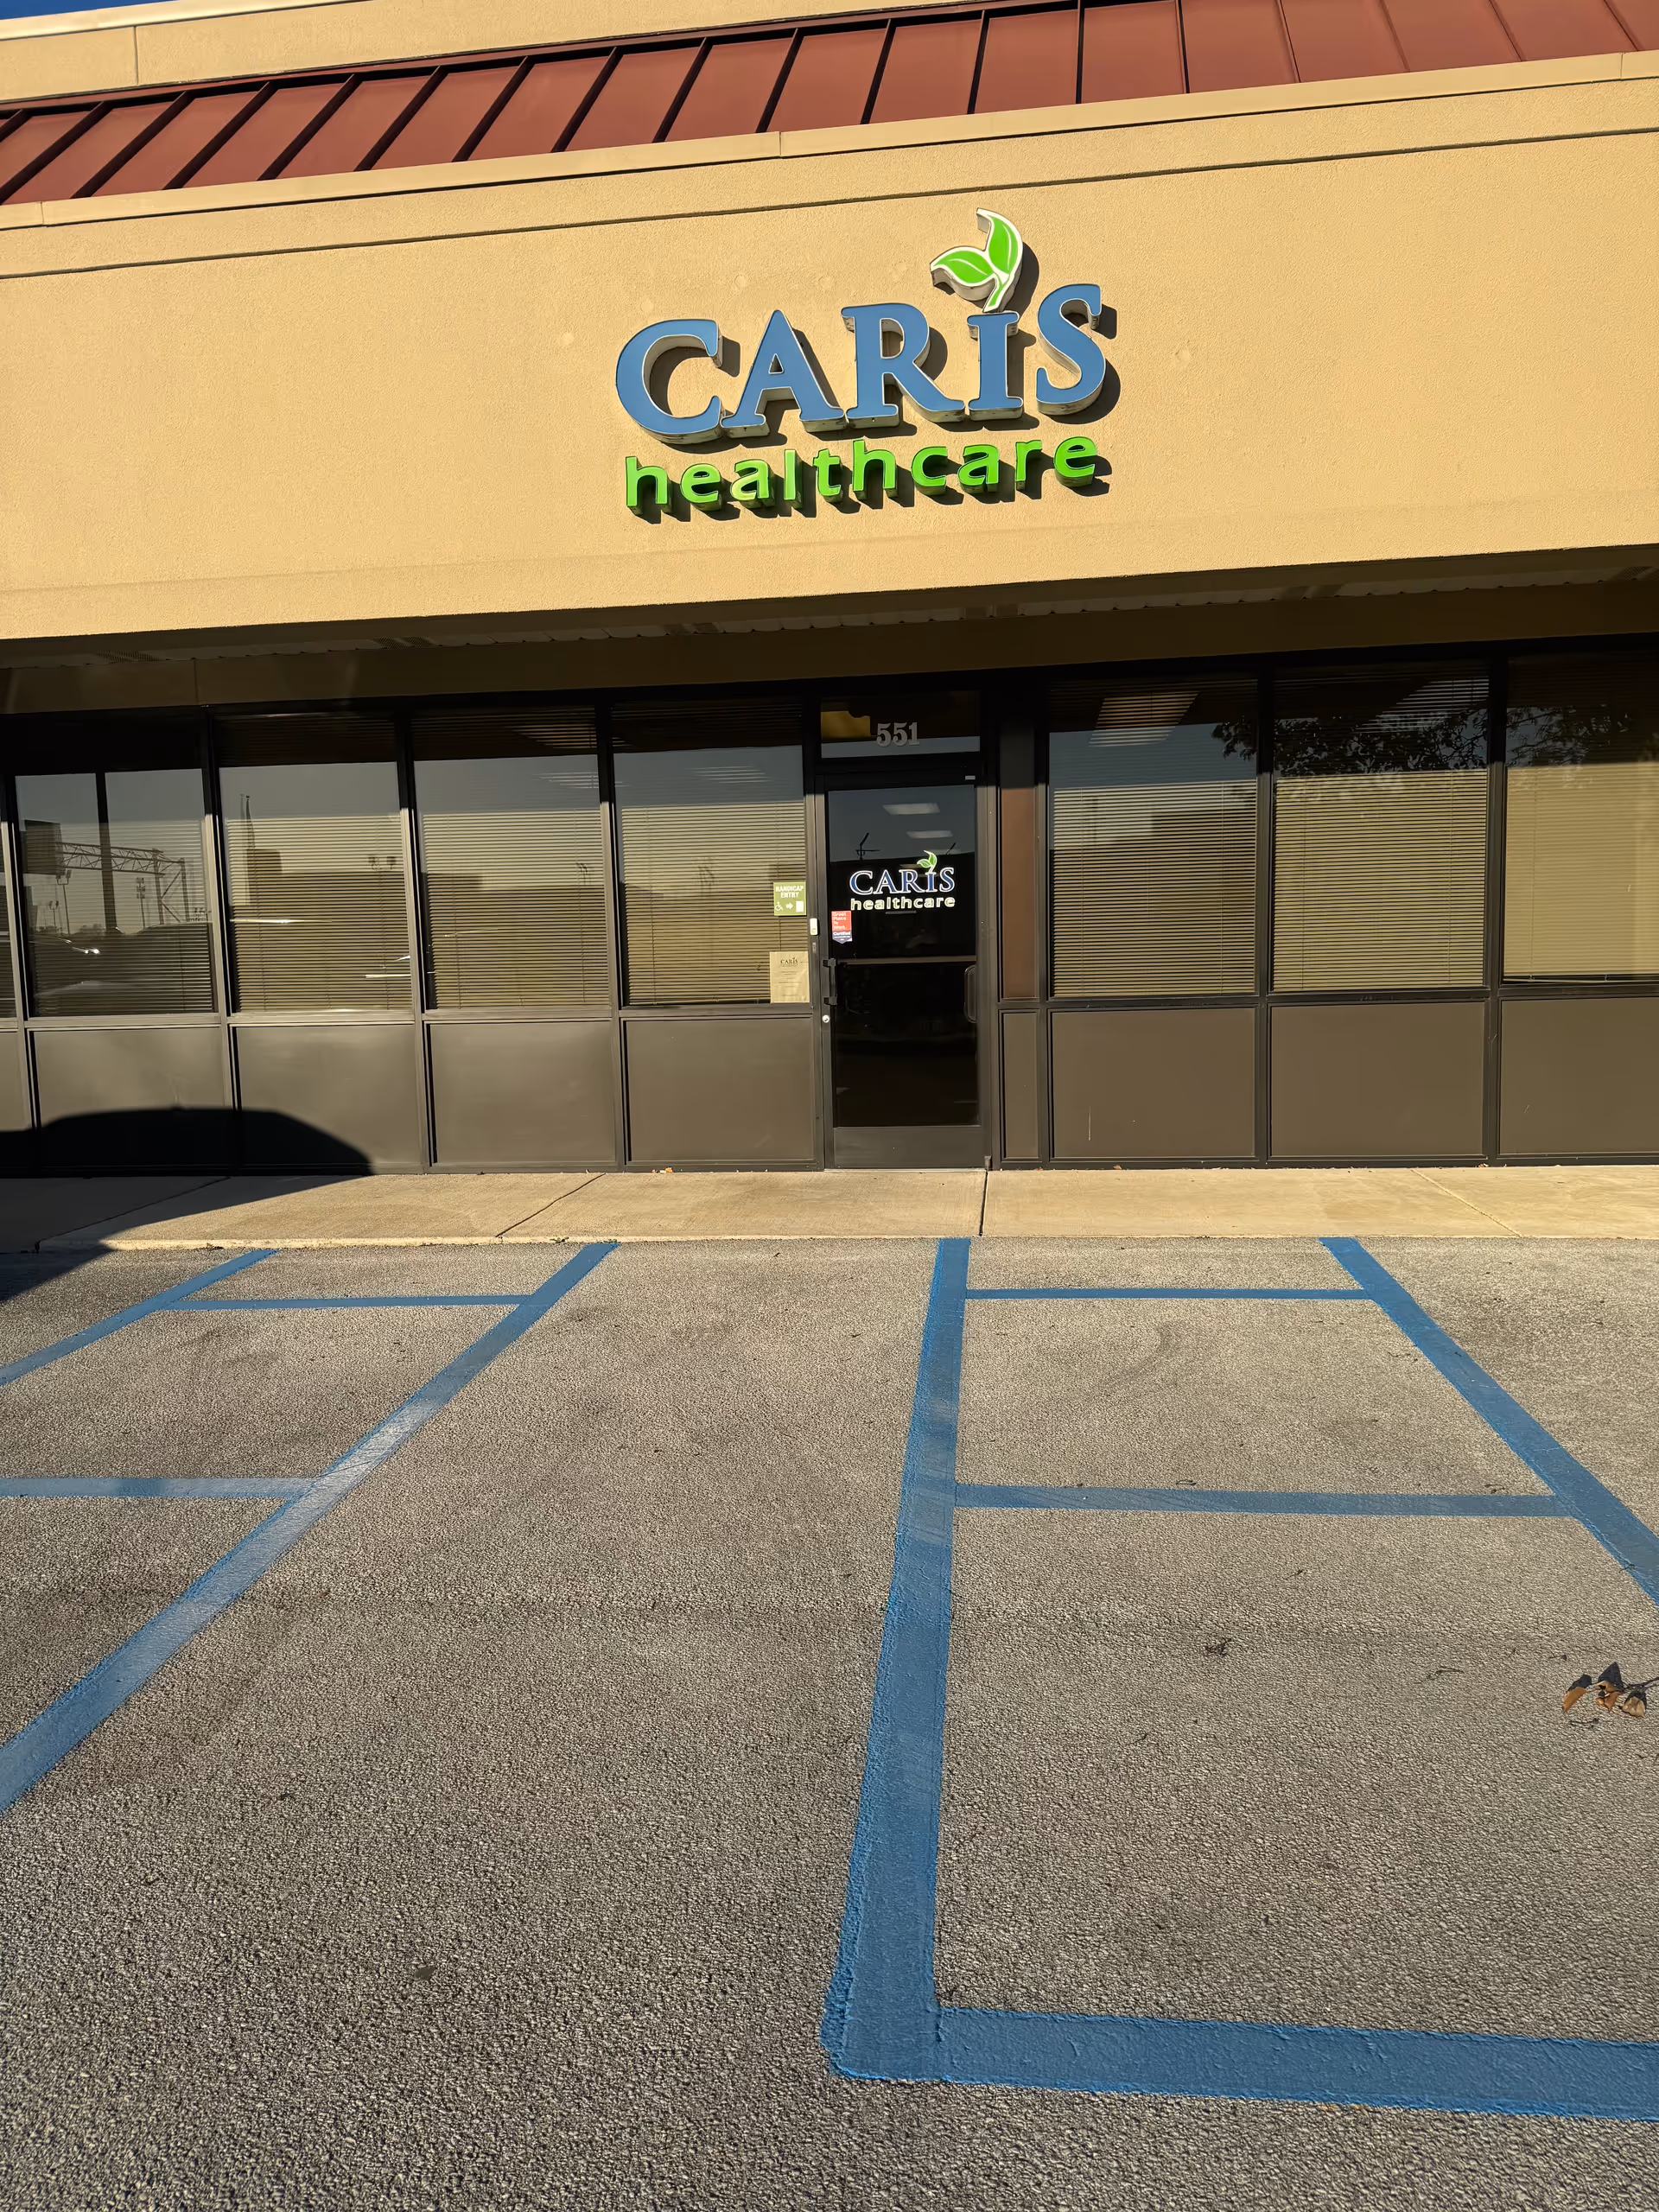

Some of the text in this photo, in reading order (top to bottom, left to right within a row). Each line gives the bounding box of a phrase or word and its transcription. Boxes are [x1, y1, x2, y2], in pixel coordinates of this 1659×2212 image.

[615, 283, 1109, 444] CARIS
[625, 435, 1098, 512] healthcare
[876, 721, 919, 747] 551
[849, 867, 955, 895] CARIS
[850, 896, 956, 911] healthcare
